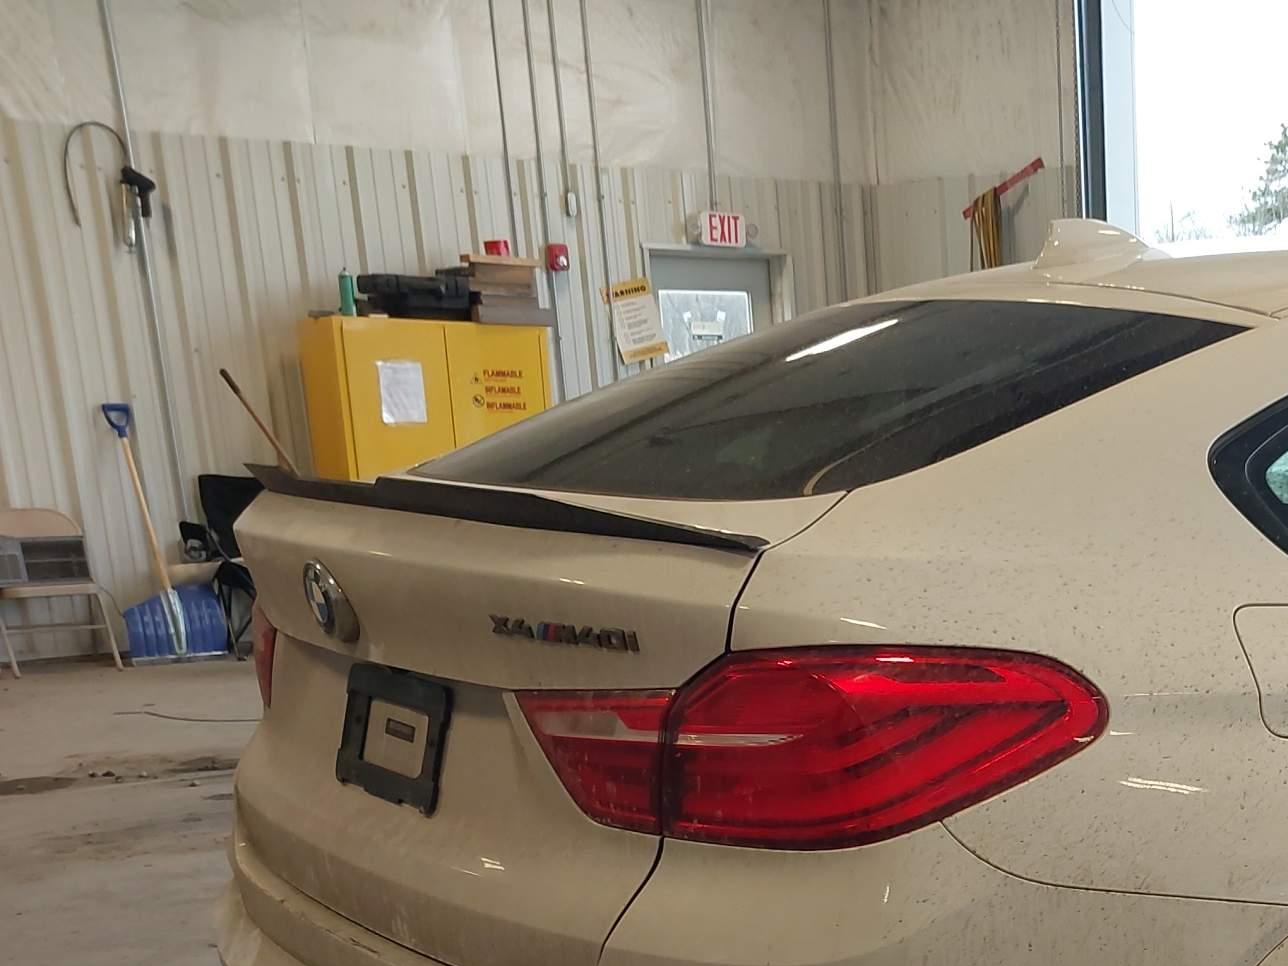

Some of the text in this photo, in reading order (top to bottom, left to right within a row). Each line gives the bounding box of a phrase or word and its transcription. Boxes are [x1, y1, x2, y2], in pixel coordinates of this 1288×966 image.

[709, 213, 740, 244] EXIT
[483, 369, 523, 379] FLAMMABLE
[488, 614, 535, 639] X4
